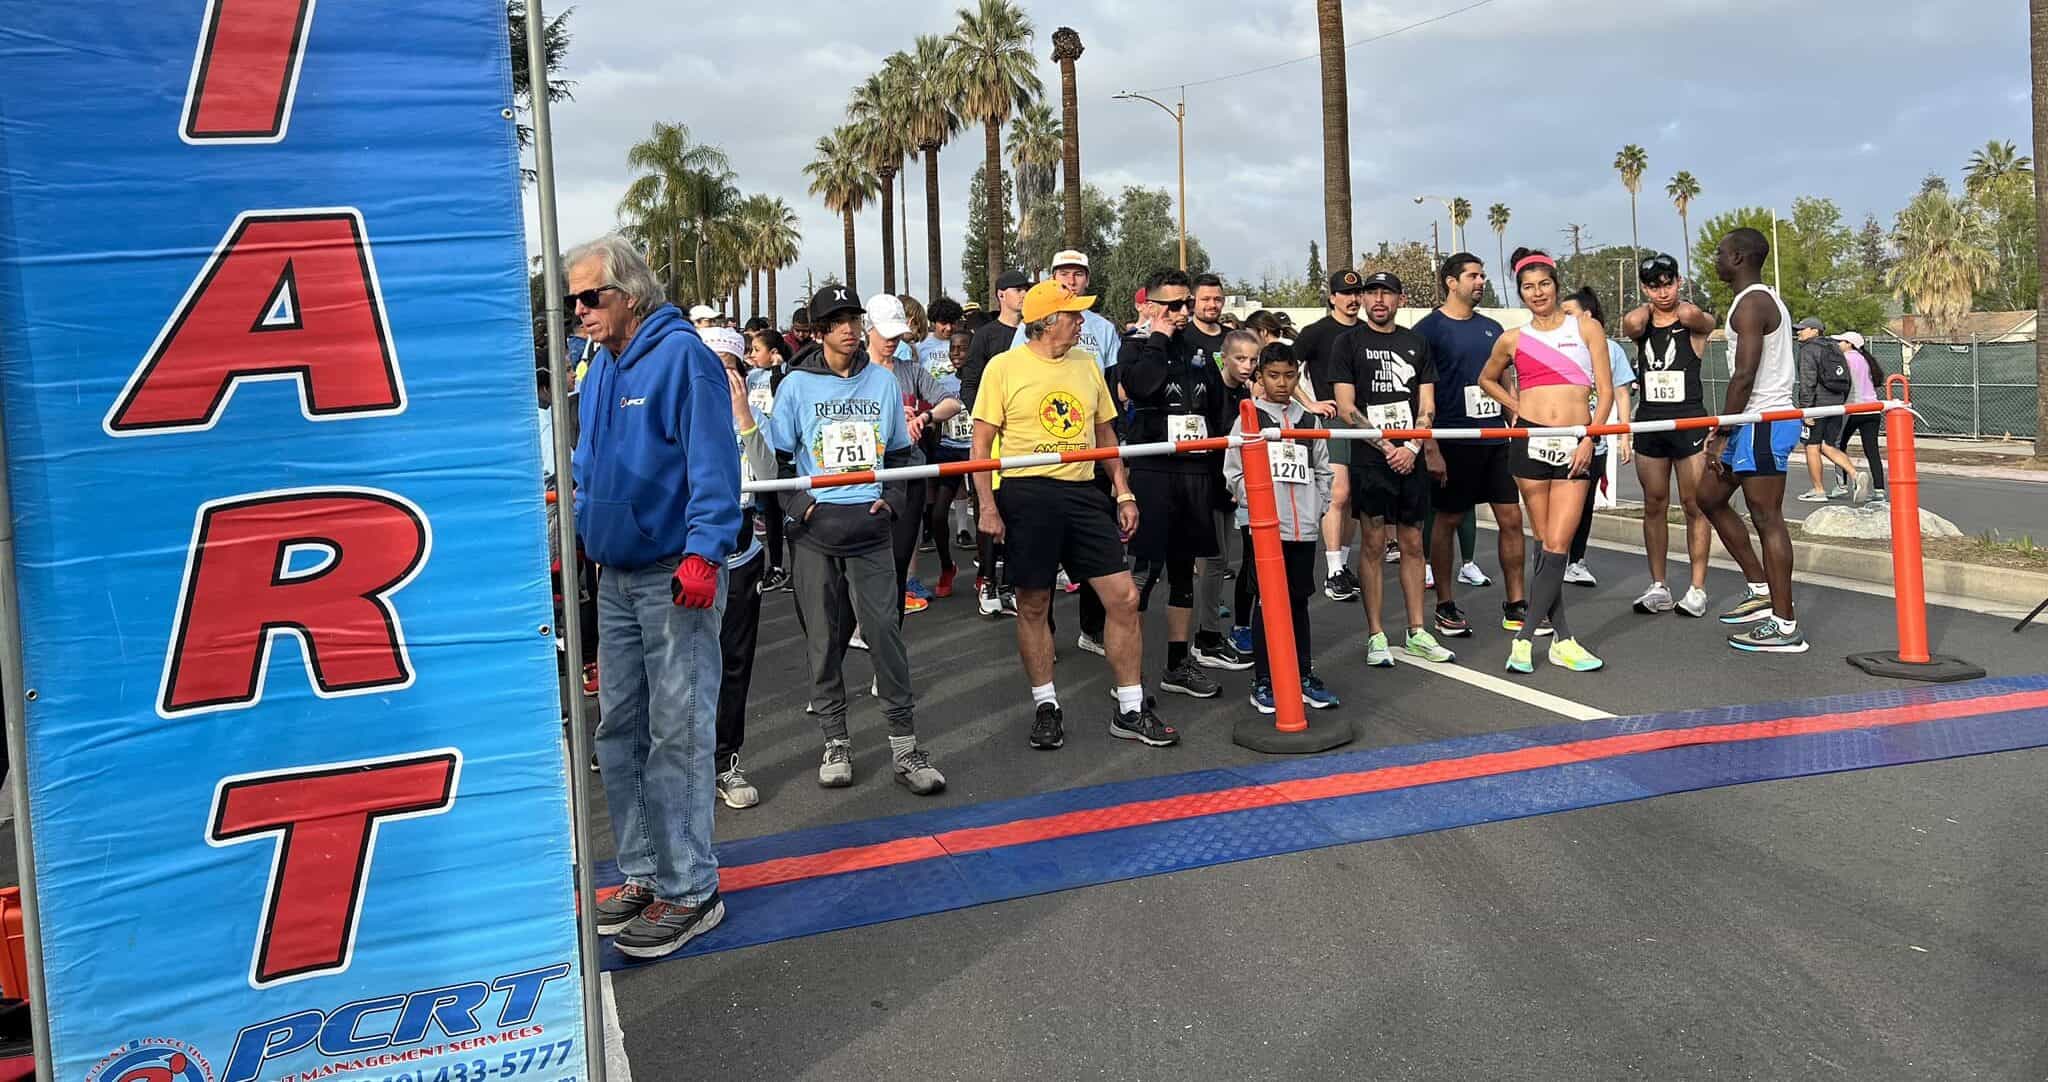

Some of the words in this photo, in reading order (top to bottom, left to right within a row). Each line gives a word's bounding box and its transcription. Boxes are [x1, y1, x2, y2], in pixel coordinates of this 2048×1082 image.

[1366, 348, 1390, 360] born
[1381, 359, 1391, 370] to
[1375, 370, 1392, 380] run
[1371, 380, 1393, 392] free
[1654, 387, 1675, 399] 163
[814, 402, 881, 420] REDLANDS
[1476, 401, 1497, 415] 121
[954, 424, 974, 437] 362
[835, 444, 866, 463] 751
[1538, 448, 1567, 464] 902
[1272, 462, 1306, 480] 1270
[220, 962, 571, 1082] PCRT
[298, 1044, 444, 1082] MANAGEMENT
[448, 1024, 545, 1053] SERVICES
